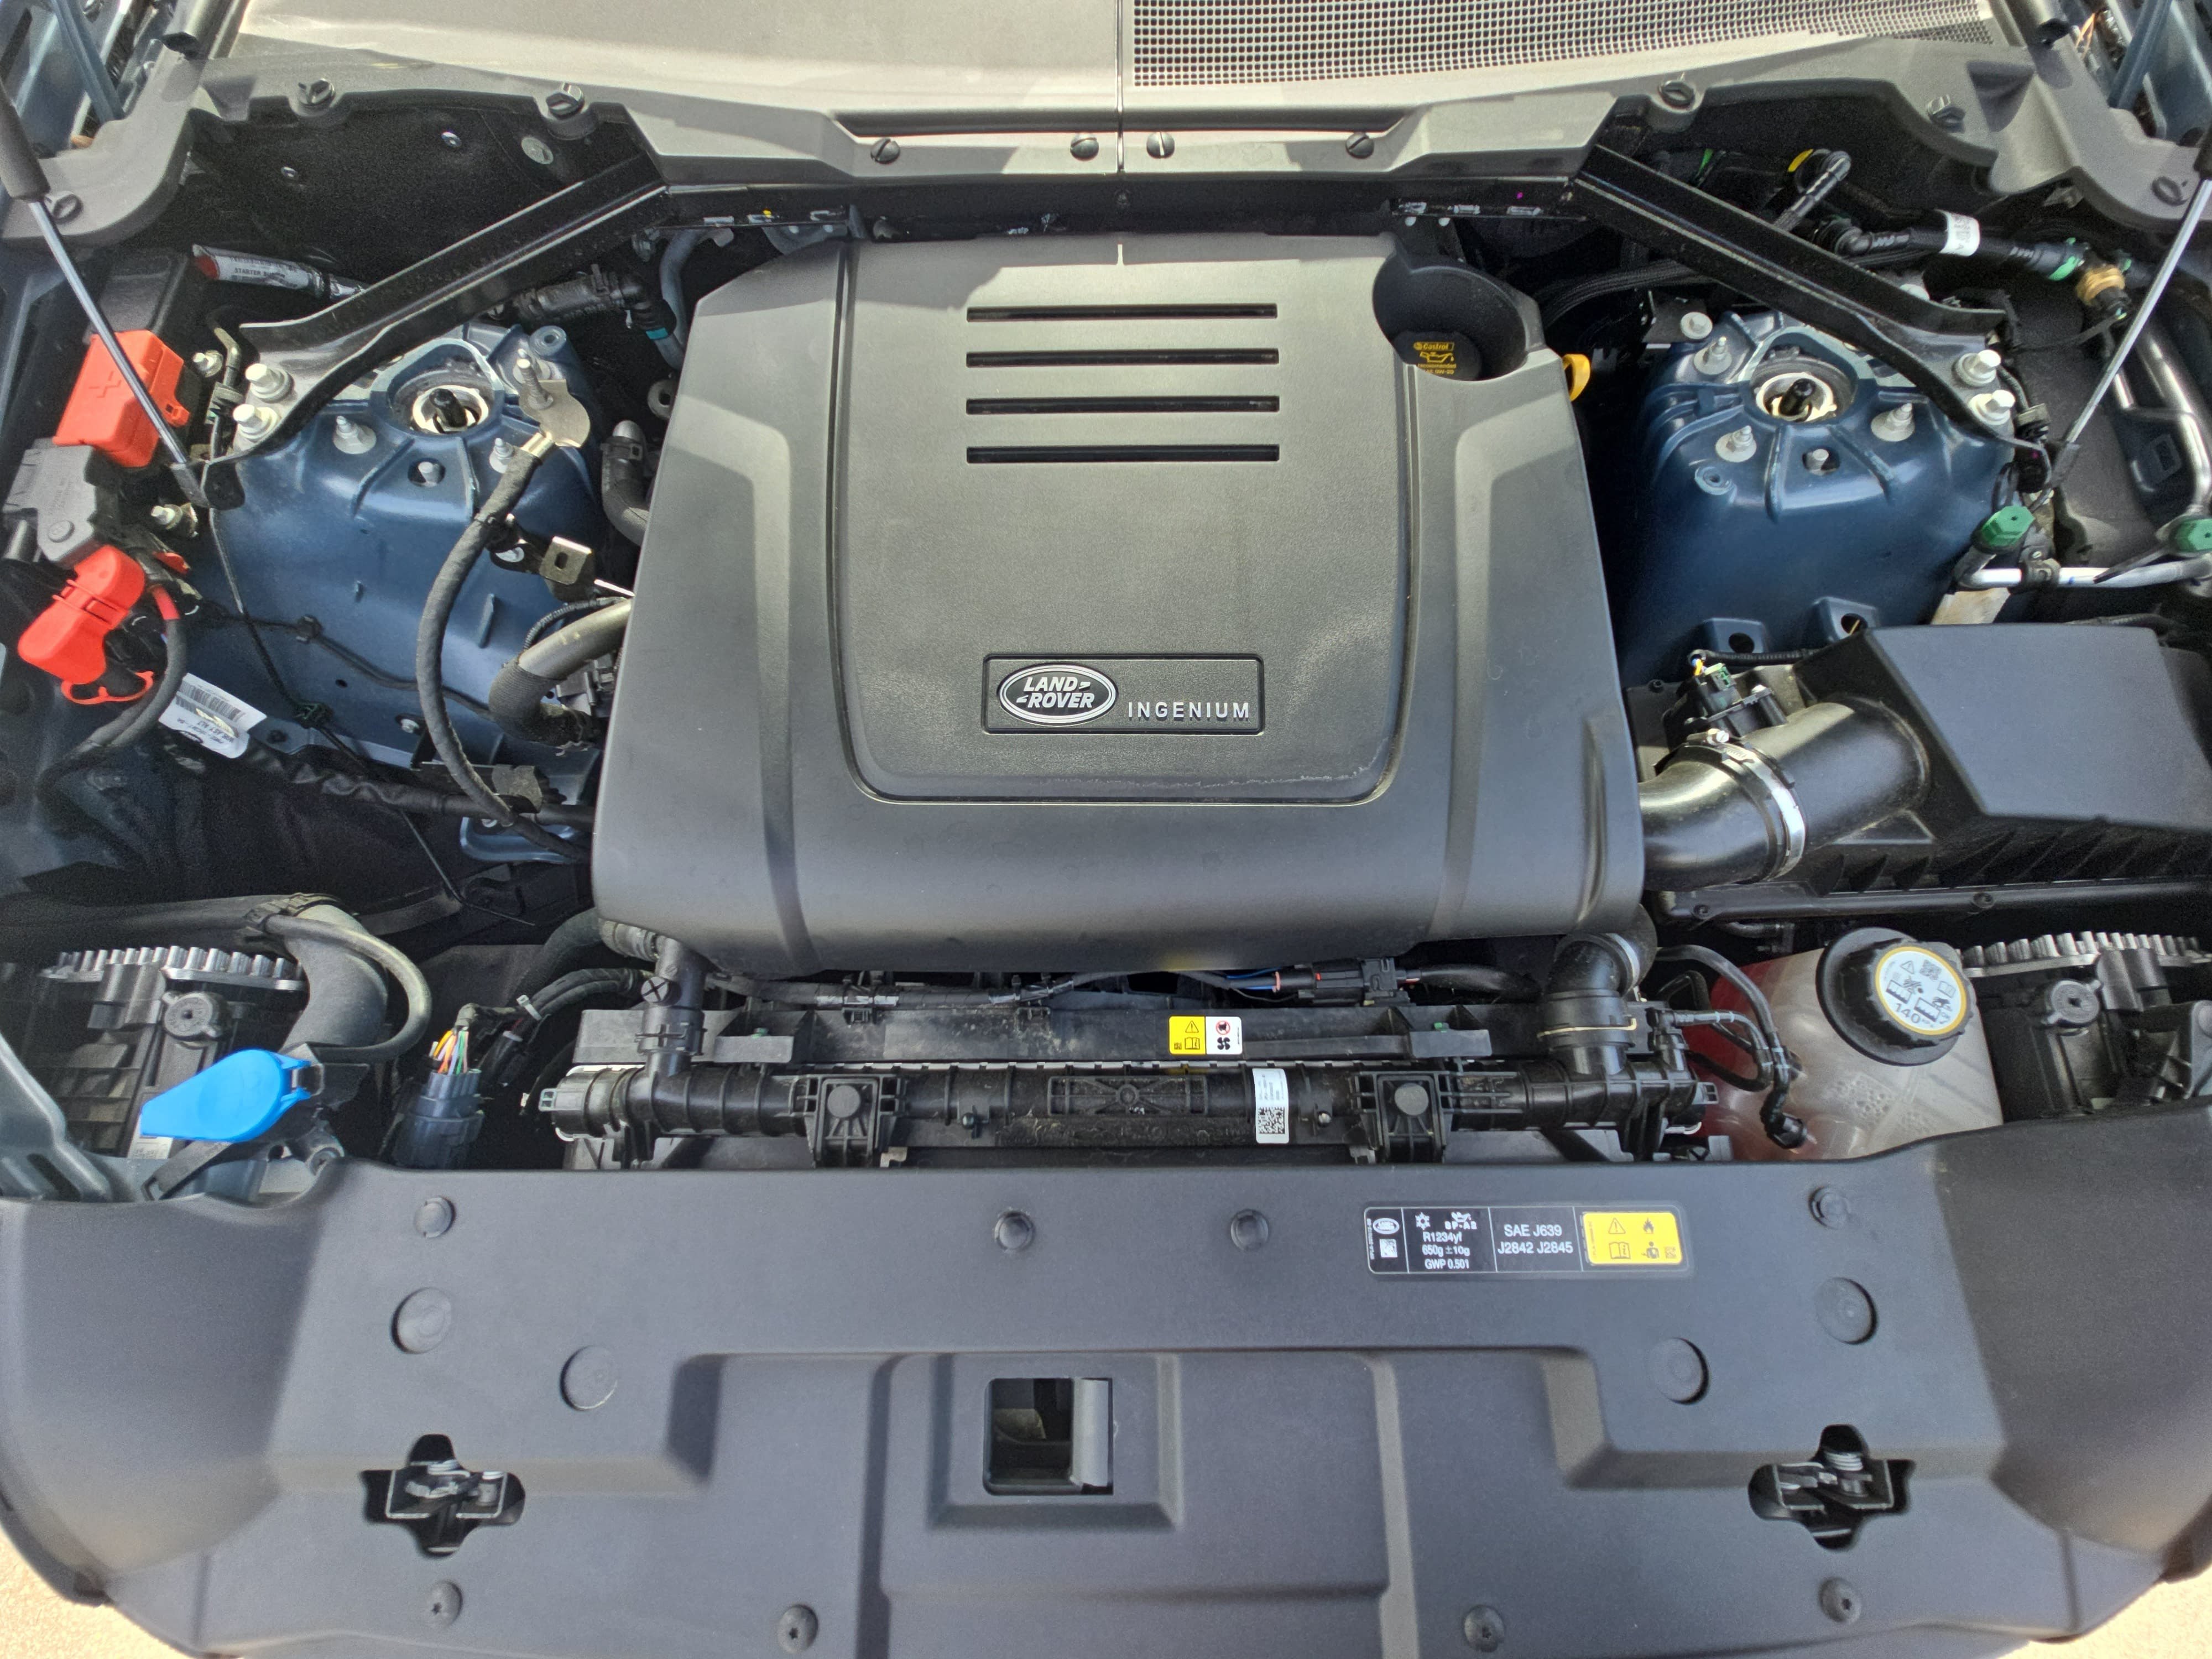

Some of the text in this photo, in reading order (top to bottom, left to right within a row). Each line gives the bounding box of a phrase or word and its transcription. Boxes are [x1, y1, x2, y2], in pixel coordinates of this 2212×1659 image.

[1024, 676, 1078, 691] LAND
[1027, 692, 1095, 708] ROVER
[1128, 701, 1250, 718] INGENIUM
[1895, 1003, 1921, 1024] 140
[1504, 1224, 1562, 1237] SAE J639
[1423, 1231, 1462, 1244] R1234yf
[1422, 1244, 1444, 1257] 650g
[1498, 1241, 1573, 1254] J2842 J2845
[1425, 1258, 1469, 1269] GWP 0.501
